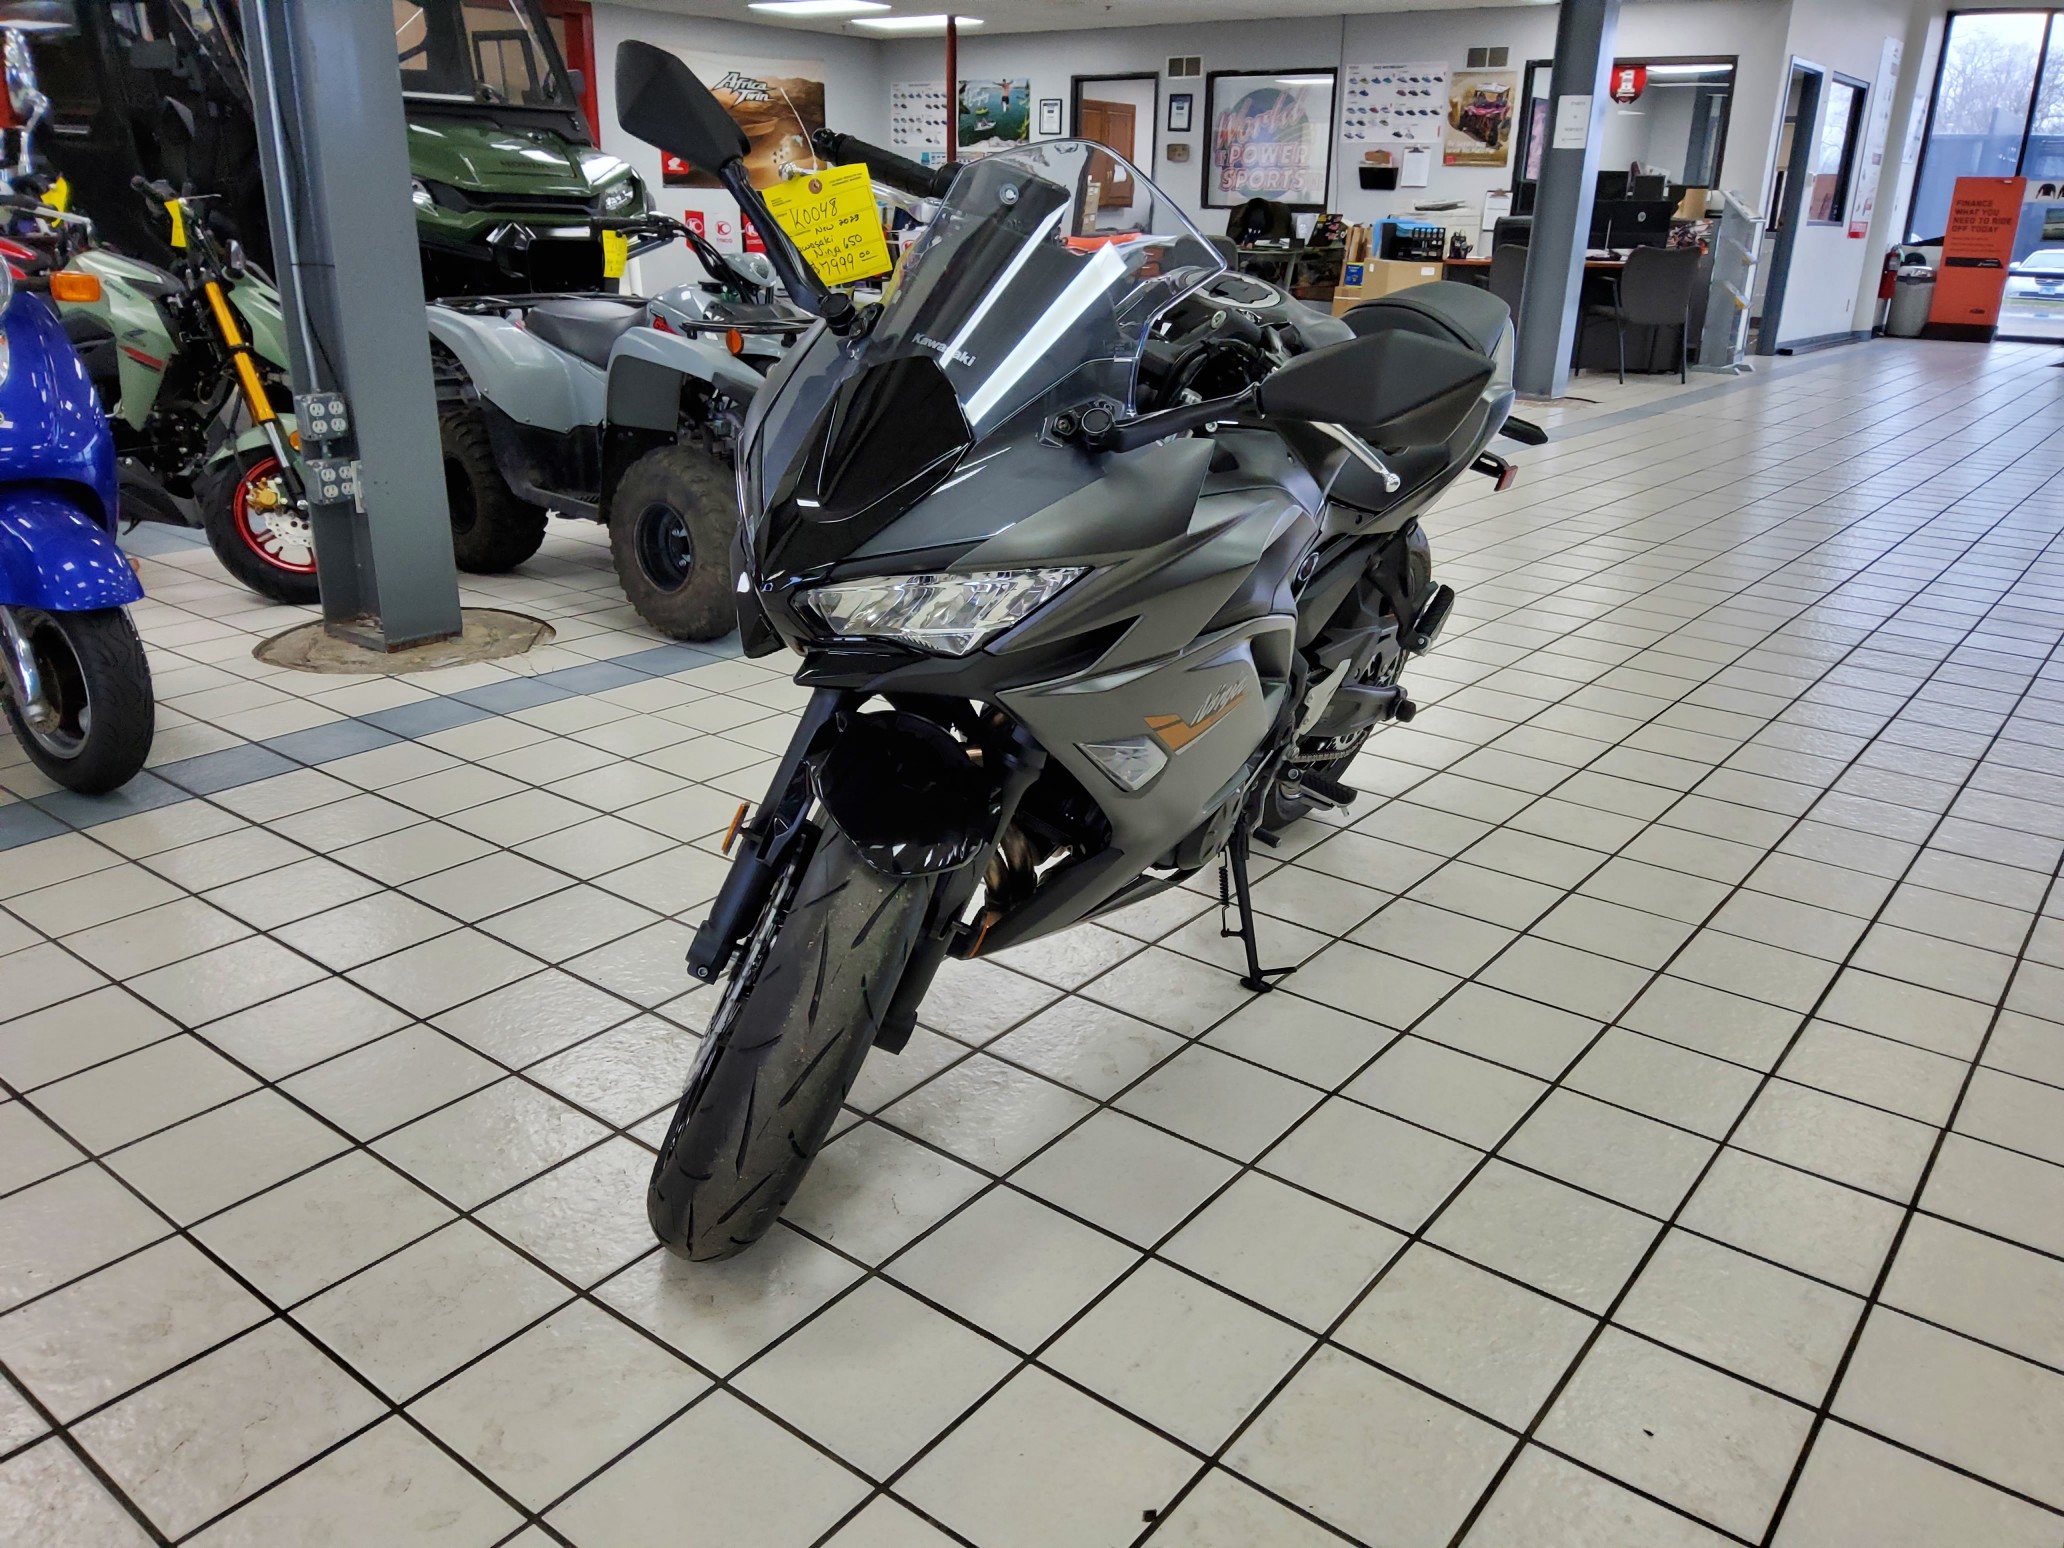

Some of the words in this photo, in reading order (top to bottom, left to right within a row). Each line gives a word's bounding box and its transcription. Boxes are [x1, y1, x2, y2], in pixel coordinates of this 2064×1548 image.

[711, 71, 776, 94] Africa
[733, 89, 776, 108] Twin
[1229, 141, 1309, 168] POWER
[1220, 167, 1309, 192] SPORTS
[789, 197, 838, 230] K0048
[1956, 199, 1993, 207] FINANCE
[1983, 208, 2000, 217] YOU
[1952, 225, 1968, 233] OFF
[1979, 217, 1990, 225] TO
[1992, 217, 2012, 225] RIDE
[797, 235, 834, 253] awasaki
[813, 245, 842, 259] Ninja
[843, 233, 863, 250] 650
[911, 332, 977, 367] Kawaaki
